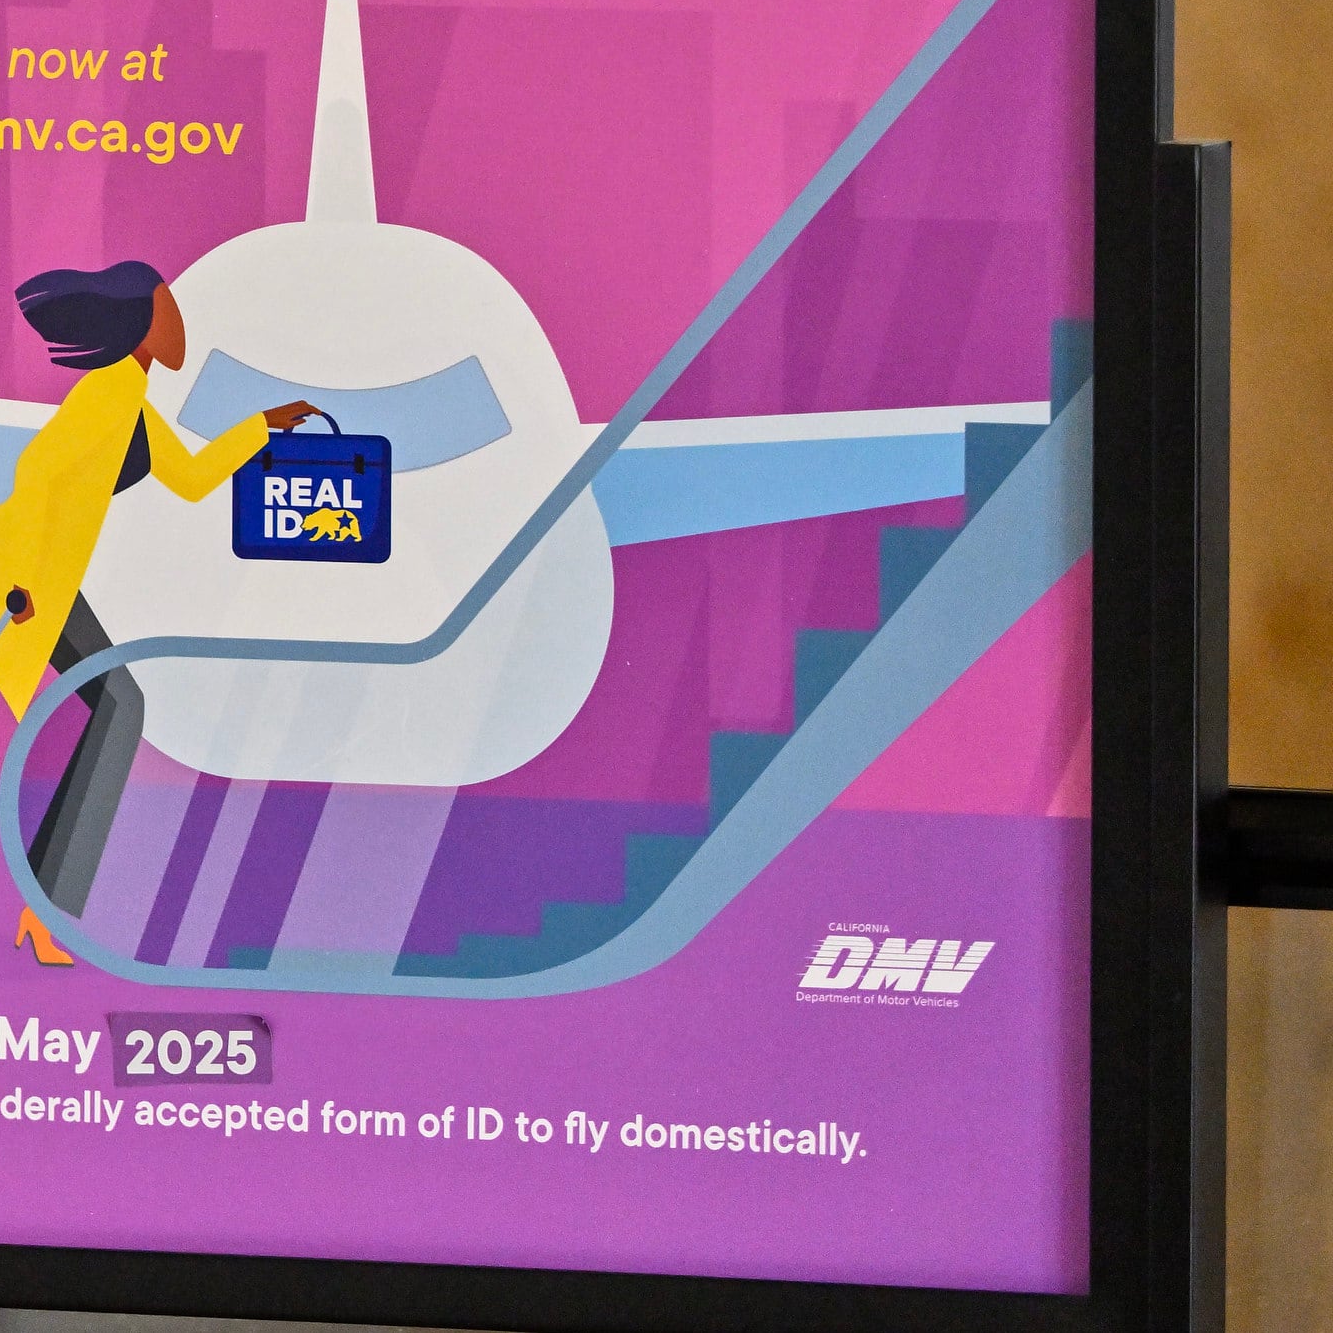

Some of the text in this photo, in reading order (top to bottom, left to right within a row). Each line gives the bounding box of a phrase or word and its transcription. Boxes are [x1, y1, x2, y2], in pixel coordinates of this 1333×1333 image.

[7, 46, 109, 81] now
[120, 43, 168, 82] at
[264, 476, 363, 509] REAL
[264, 508, 304, 539] ID
[828, 922, 890, 934] CALIFORNIA
[797, 935, 996, 994] DMV
[795, 991, 959, 1008] Department of Motor Vehicles
[124, 1029, 258, 1076] 2025
[133, 1099, 310, 1137] accepted
[320, 1100, 406, 1138] form
[417, 1105, 455, 1140] of
[466, 1106, 504, 1141] ID
[515, 1111, 553, 1144] to
[564, 1110, 609, 1154] fly
[619, 1114, 868, 1165] domestically.
